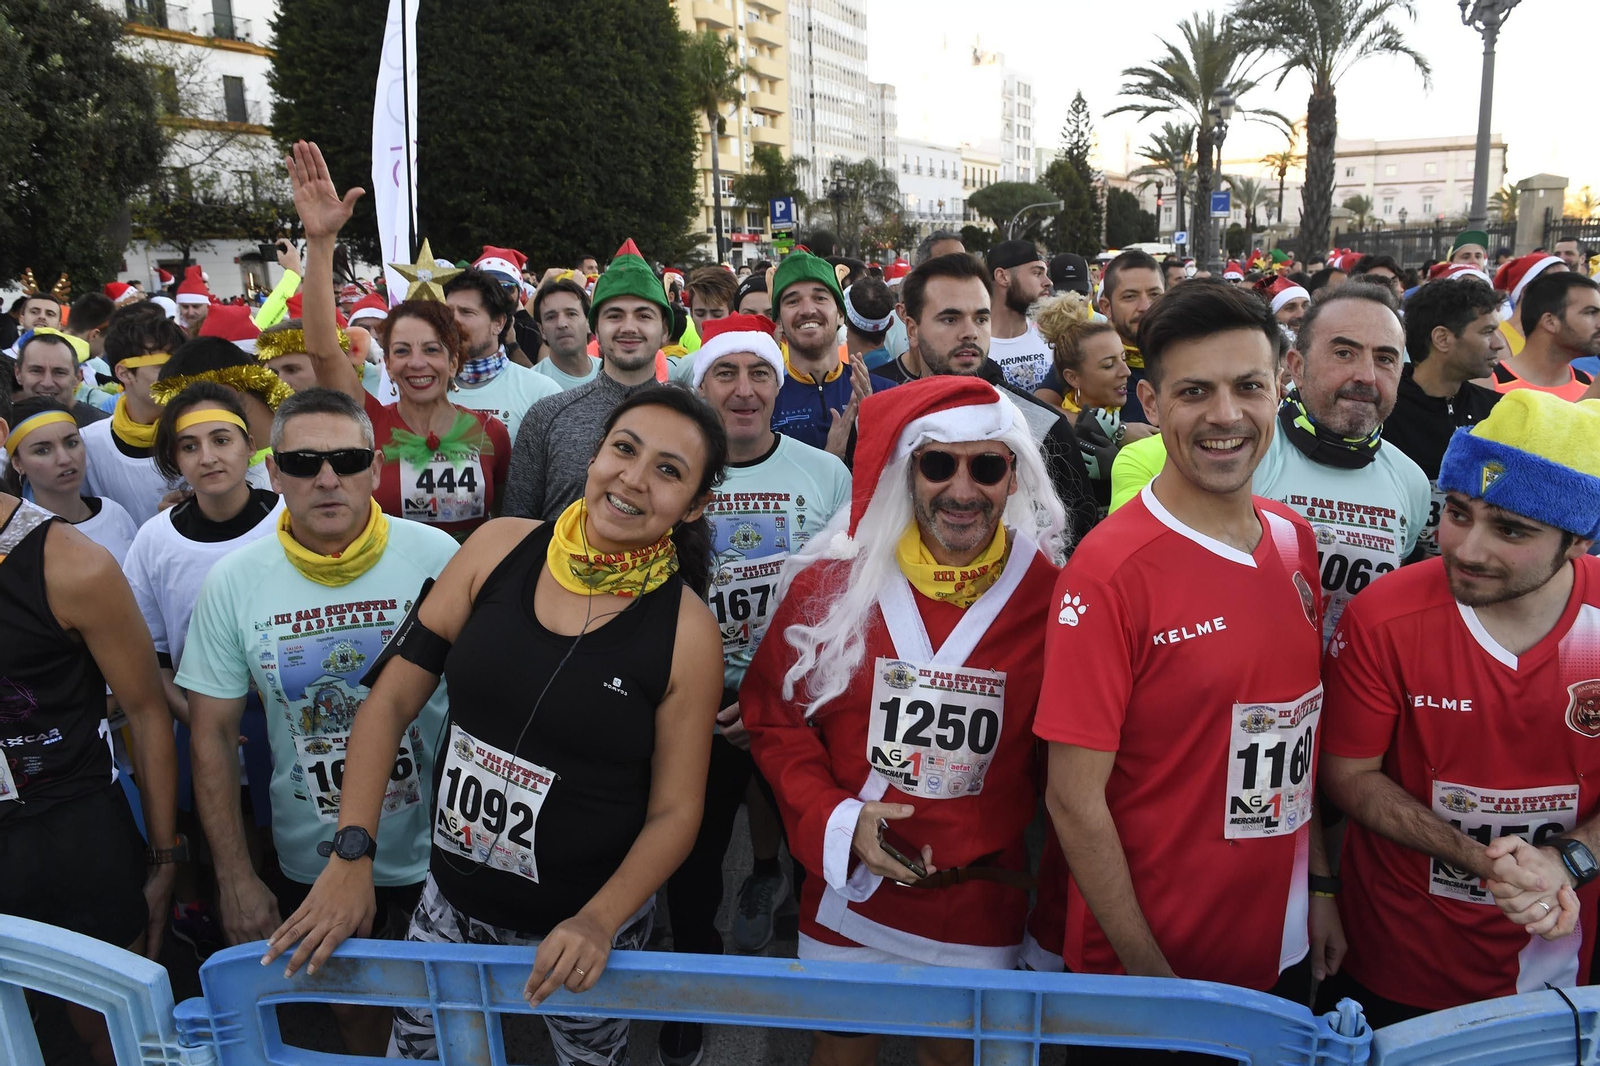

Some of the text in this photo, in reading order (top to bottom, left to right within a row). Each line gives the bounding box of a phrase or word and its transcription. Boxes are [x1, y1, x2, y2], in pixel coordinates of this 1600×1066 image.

[775, 201, 786, 217] P
[995, 353, 1045, 366] ARUNNERS
[416, 467, 477, 494] 444
[734, 493, 790, 501] SILVESTRE
[708, 502, 781, 511] GADITANA
[1291, 495, 1396, 519] III SAN SILVESTRE
[1307, 508, 1389, 528] GADITANA
[1346, 537, 1391, 551] GADITANA
[1347, 531, 1361, 539] SAN
[1362, 533, 1395, 546] SILVESTRE
[594, 553, 625, 564] SAN
[934, 565, 989, 581] III SAN
[274, 599, 397, 625] III SAN SILVESTRE
[292, 611, 386, 634] GADITANA
[1059, 616, 1077, 624] KELME
[1152, 616, 1227, 645] KELME
[919, 669, 931, 678] III
[934, 671, 953, 680] SAN
[930, 678, 995, 694] GADITANA
[1278, 710, 1291, 718] III
[879, 697, 999, 755] 1250
[1237, 726, 1312, 790] 1160
[476, 746, 551, 786] III SAN SILVESTRE
[950, 764, 971, 773] aefat
[482, 758, 538, 790] GADITANA
[1480, 793, 1577, 805] III SAN SILVESTRE
[1494, 800, 1567, 812] GADITANA
[446, 766, 533, 850] 1092
[1229, 817, 1265, 825] MERCHAN
[1433, 877, 1470, 890] MERCHAN
